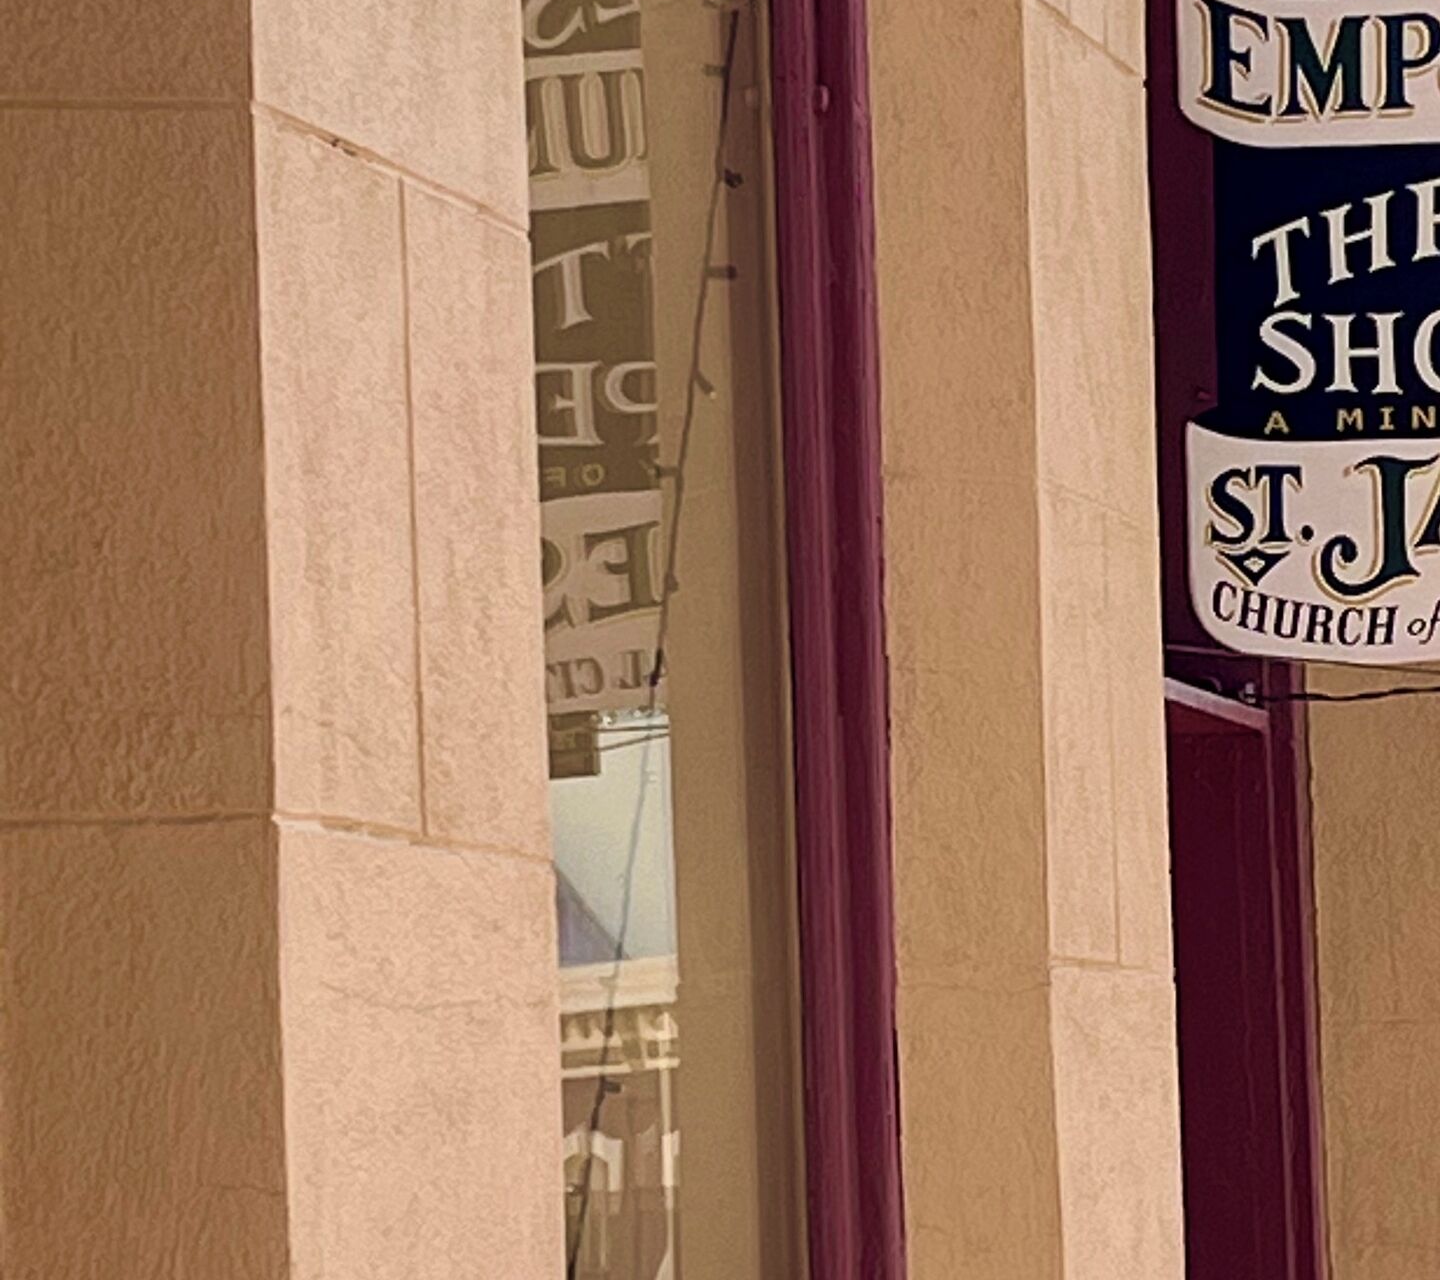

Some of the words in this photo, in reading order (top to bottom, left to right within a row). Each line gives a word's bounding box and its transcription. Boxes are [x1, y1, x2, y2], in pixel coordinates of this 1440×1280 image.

[1263, 410, 1290, 435] A
[1207, 464, 1314, 548] ST.
[1212, 581, 1398, 647] CHURCH
